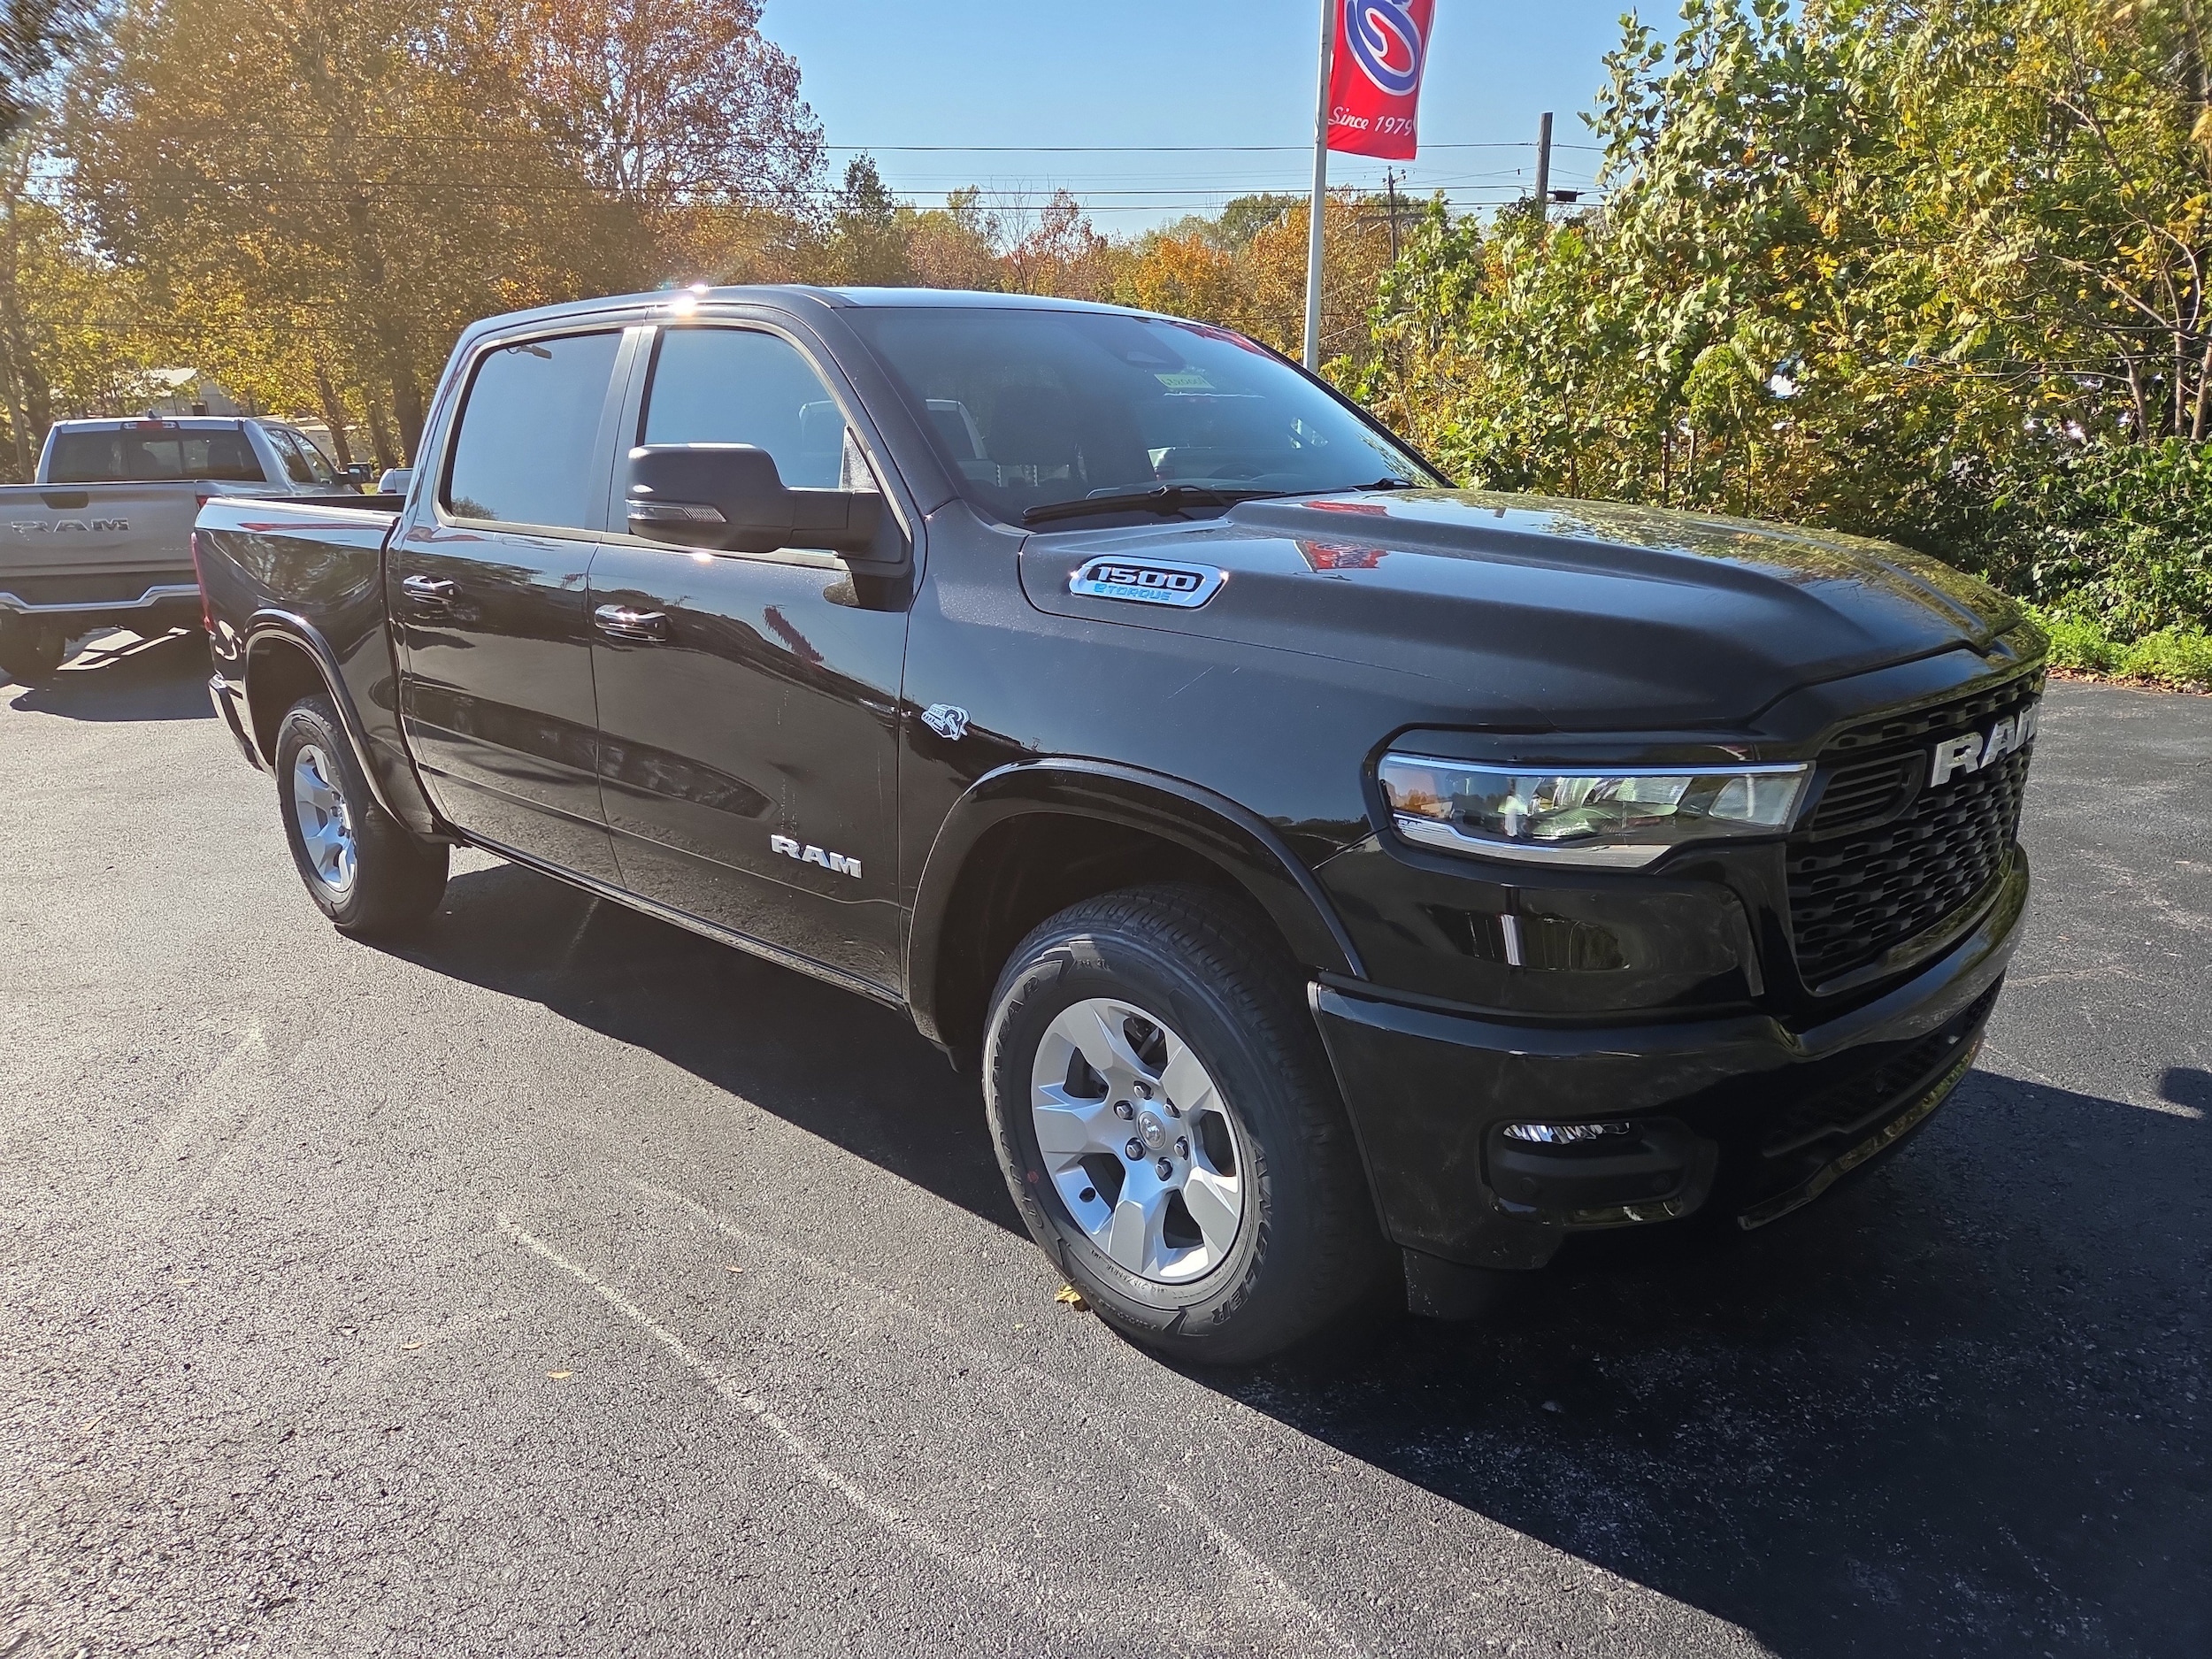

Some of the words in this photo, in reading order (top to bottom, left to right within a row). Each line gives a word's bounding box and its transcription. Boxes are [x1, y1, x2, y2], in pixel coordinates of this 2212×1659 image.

[1328, 106, 1369, 130] Since
[1374, 116, 1413, 136] 1979
[11, 518, 130, 533] RAM
[1098, 566, 1197, 591] 1500
[770, 833, 863, 879] RAM
